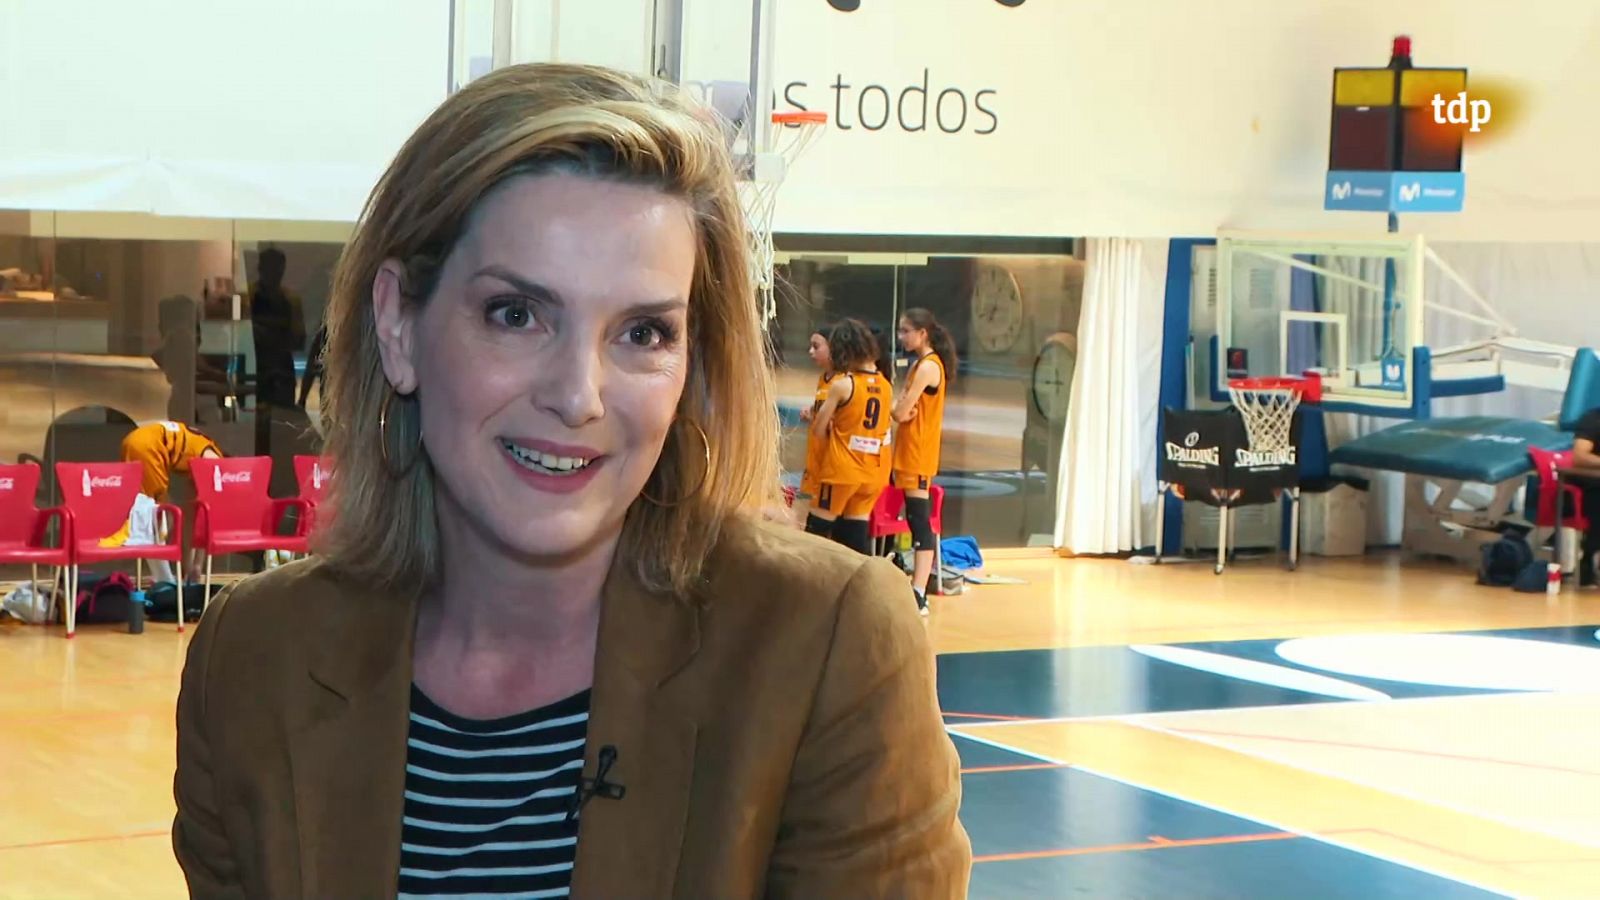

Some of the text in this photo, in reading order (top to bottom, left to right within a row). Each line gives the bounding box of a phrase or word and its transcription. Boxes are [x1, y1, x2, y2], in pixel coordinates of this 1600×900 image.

[830, 67, 998, 134] todos
[864, 397, 880, 429] 9
[1165, 441, 1219, 466] SPALDING
[1234, 446, 1296, 467] SPALDING
